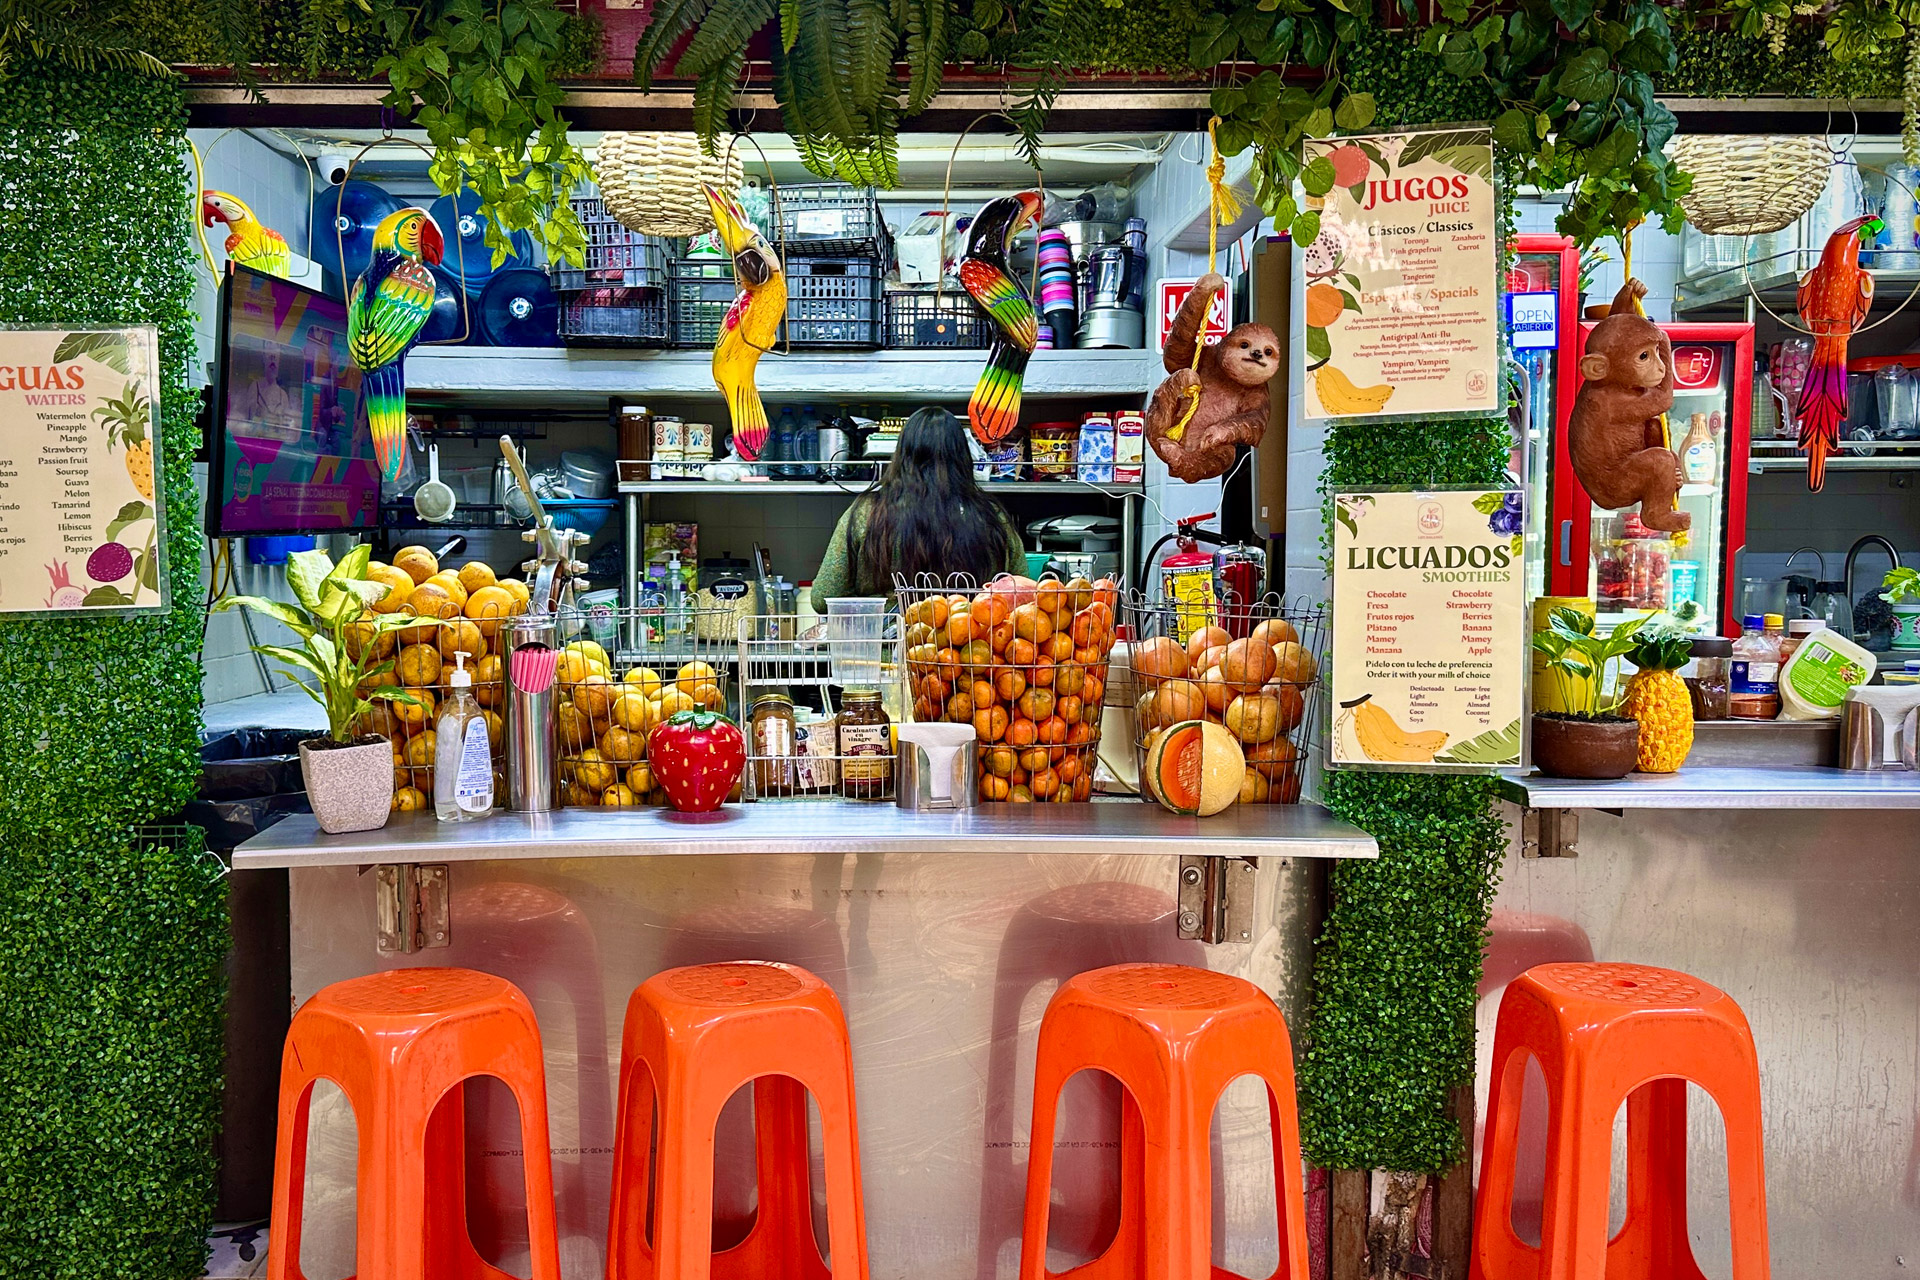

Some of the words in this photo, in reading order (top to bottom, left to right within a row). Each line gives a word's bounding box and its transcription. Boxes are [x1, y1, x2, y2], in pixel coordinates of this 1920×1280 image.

[1364, 174, 1469, 211] JUGOS
[1428, 201, 1470, 218] JUICE
[1426, 220, 1474, 233] Classics
[1451, 234, 1486, 242] Zanahoria
[1407, 246, 1442, 256] grapefruit
[1401, 259, 1437, 267] Mandarina
[1402, 273, 1436, 281] Tangerine
[1515, 309, 1553, 322] OPEN
[1515, 322, 1553, 332] ABIERTO
[25, 393, 86, 405] WATERS
[36, 412, 86, 420] Watermelon
[47, 423, 87, 433] Pineapple
[59, 434, 88, 444] Mango
[42, 446, 88, 455] Strawberry
[38, 457, 69, 465] Passion
[70, 456, 89, 464] fruit
[56, 468, 89, 477] Soursop
[51, 501, 91, 509] Tamarind
[57, 523, 92, 531] Hibiscus
[6, 536, 26, 545] rojos
[63, 534, 93, 542] Berries
[64, 545, 93, 555] Papaya
[1347, 545, 1511, 570] LICUADOS
[1422, 571, 1511, 583] SMOOTHIES
[1366, 590, 1407, 598] Chocolate
[1452, 590, 1493, 598] Chocolate
[1366, 601, 1389, 610] Fresa
[1446, 601, 1493, 611] Strawberry
[1366, 613, 1393, 621] Frutos
[1394, 613, 1415, 623] rojos
[1462, 612, 1493, 620] Berries
[1462, 623, 1493, 632] Banana
[1366, 635, 1397, 645] Mamey
[1461, 635, 1493, 645] Mamey
[1366, 646, 1403, 654] Manzana
[1467, 646, 1493, 657] Apple
[1416, 660, 1437, 668] leche
[1437, 660, 1448, 668] de
[1448, 660, 1493, 670] preferencia
[1367, 670, 1391, 678] Order
[1418, 672, 1436, 680] your
[1437, 671, 1455, 679] milk
[1456, 671, 1465, 679] of
[1465, 671, 1491, 679] choice
[1478, 717, 1491, 725] Soy
